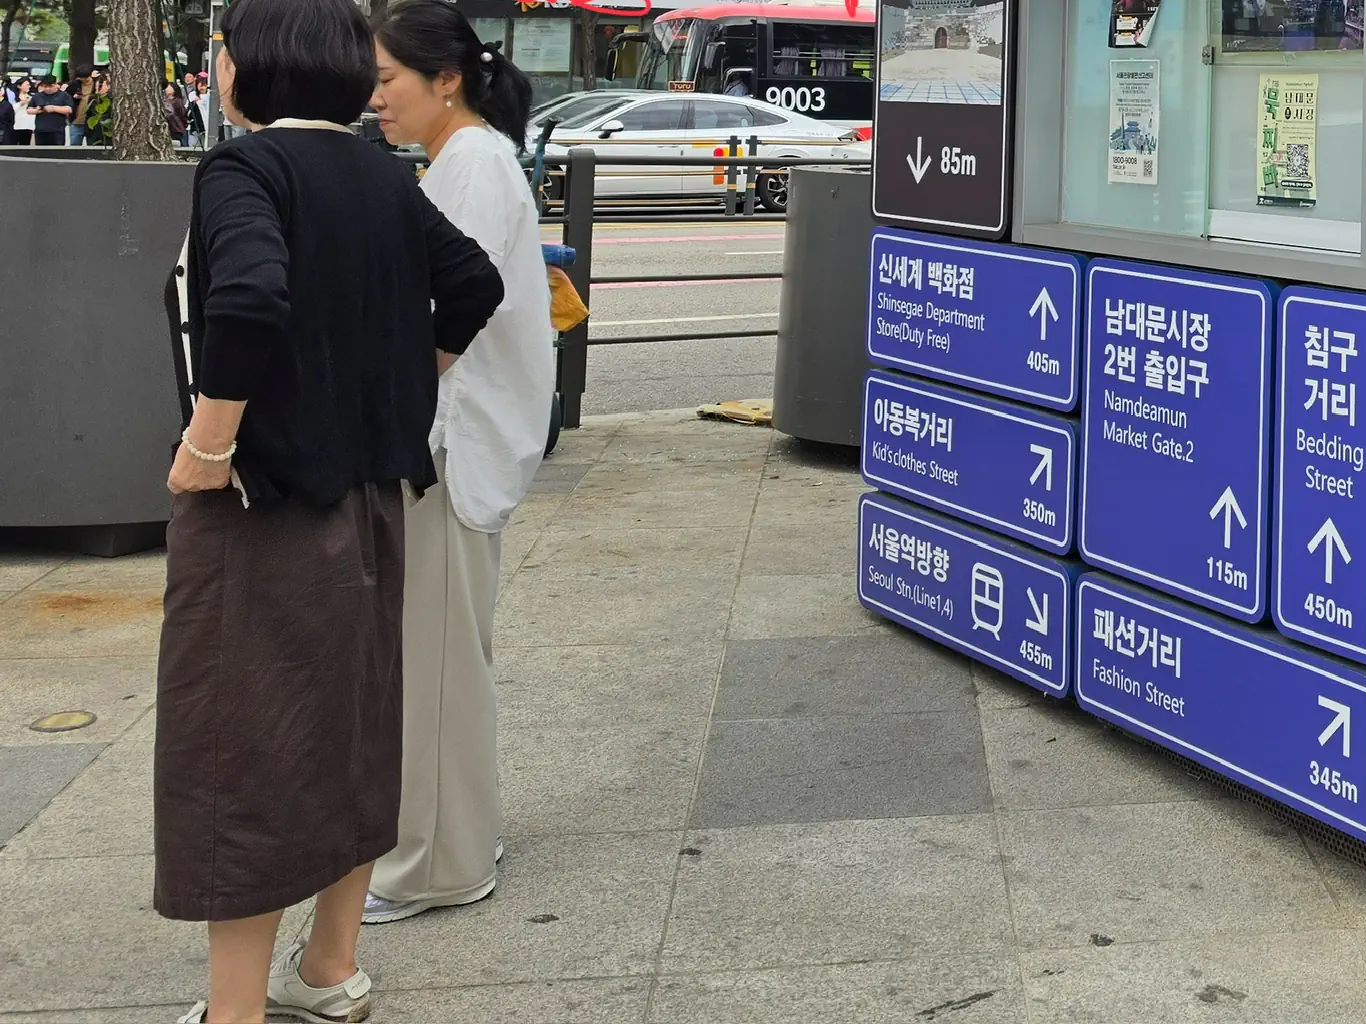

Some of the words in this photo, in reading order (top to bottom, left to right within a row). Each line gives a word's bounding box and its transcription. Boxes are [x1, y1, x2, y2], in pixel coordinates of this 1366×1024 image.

[765, 86, 826, 112] 9003
[940, 146, 976, 177] 85m
[878, 252, 923, 291] 신세계
[927, 261, 975, 301] 백화점
[877, 291, 923, 320] Shinsegae
[926, 301, 985, 332] Department
[1103, 297, 1212, 353] 남대문시장
[876, 317, 924, 349] Store(Duty
[926, 328, 951, 354] Free)
[1303, 324, 1359, 374] 침구
[1026, 350, 1060, 376] 405m
[1103, 342, 1137, 385] 2번
[1143, 349, 1210, 400] 출입구
[1103, 388, 1188, 430] Namdeamun
[1303, 377, 1356, 428] 거리
[873, 397, 953, 453] 아동복거리
[1102, 419, 1148, 452] Market
[1151, 431, 1195, 464] Gate.2
[893, 447, 927, 476] clothes
[929, 460, 959, 487] Street
[1296, 428, 1364, 472] Bedding
[1304, 465, 1354, 500] Street
[1022, 497, 1057, 527] 350m
[868, 522, 950, 583] 서울역방향
[1206, 555, 1249, 592] 115m
[868, 563, 894, 593] Seoul
[896, 576, 954, 621] Stn.(Line1,4)
[1303, 592, 1353, 631] 450m
[1019, 639, 1053, 671] 455m
[1092, 607, 1182, 680] 패션거리
[1092, 657, 1141, 698] Fashion
[1145, 681, 1185, 718] Street
[1309, 760, 1358, 805] 345m
